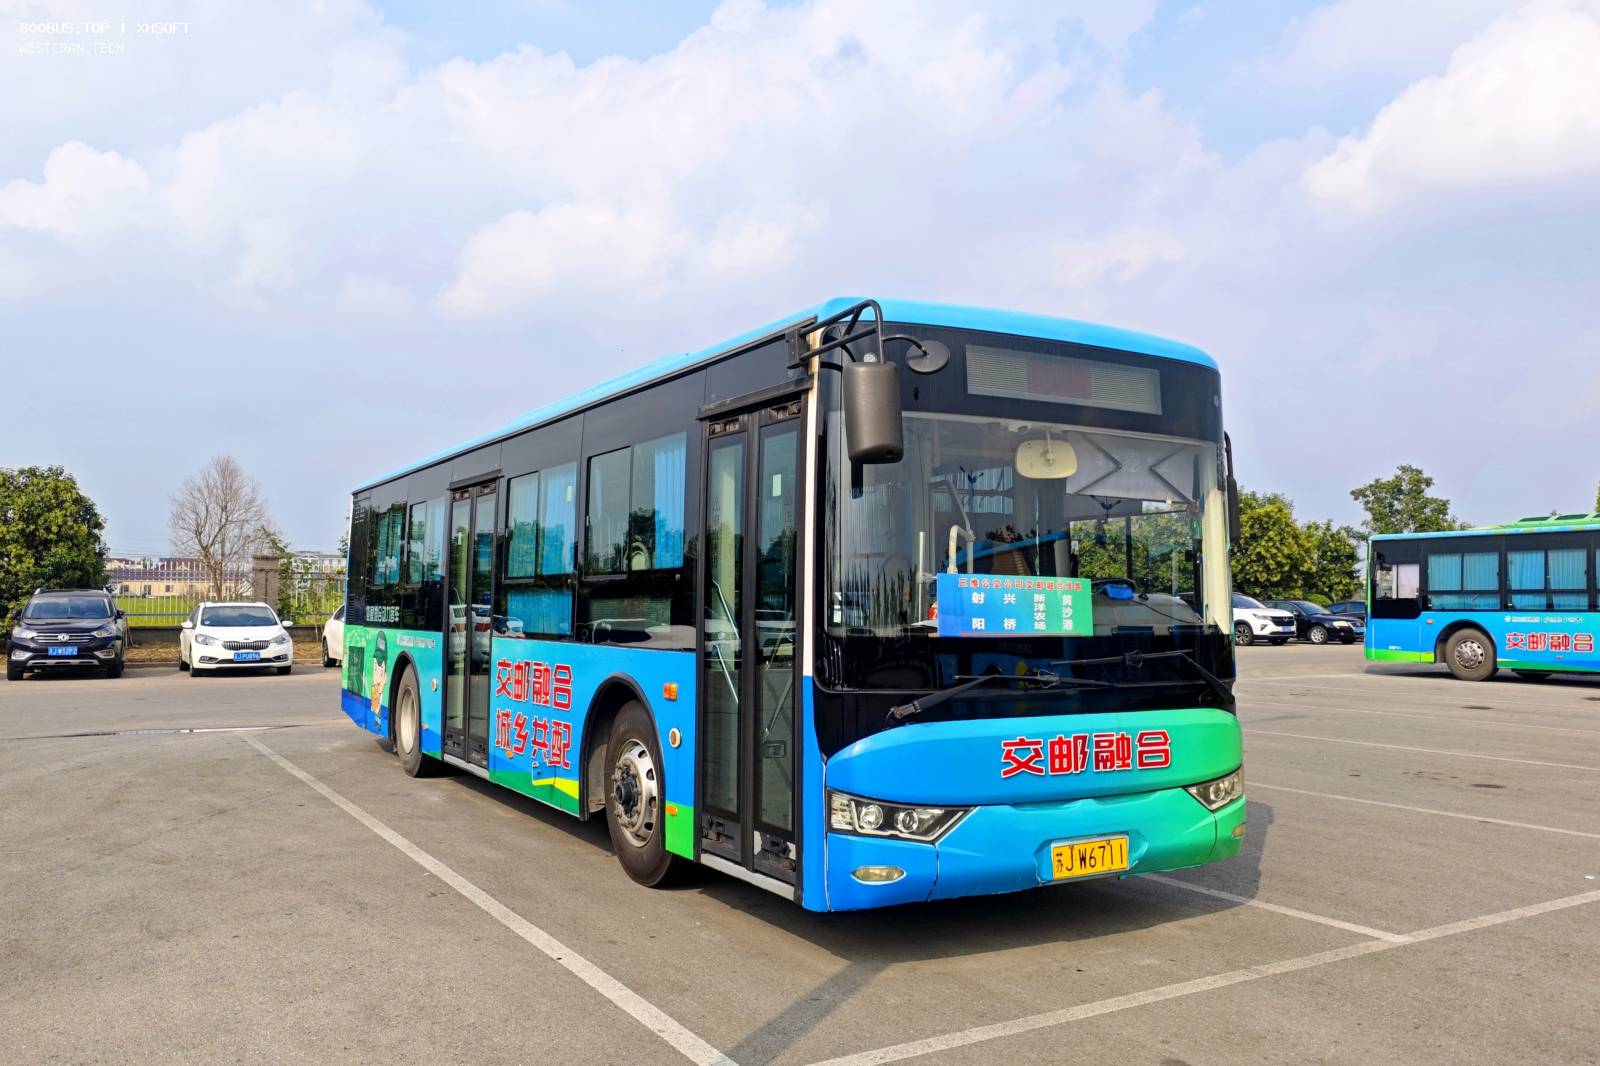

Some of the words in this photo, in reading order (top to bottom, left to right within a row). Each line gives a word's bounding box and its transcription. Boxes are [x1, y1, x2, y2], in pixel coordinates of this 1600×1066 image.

[971, 591, 985, 630] 射阳
[1003, 593, 1017, 630] 兴桥
[1033, 593, 1047, 631] 新洋农场
[1506, 633, 1593, 652] 交邮融合
[495, 659, 573, 711] 交邮融合
[495, 708, 572, 770] 城乡共配
[1001, 730, 1171, 778] 交邮融合
